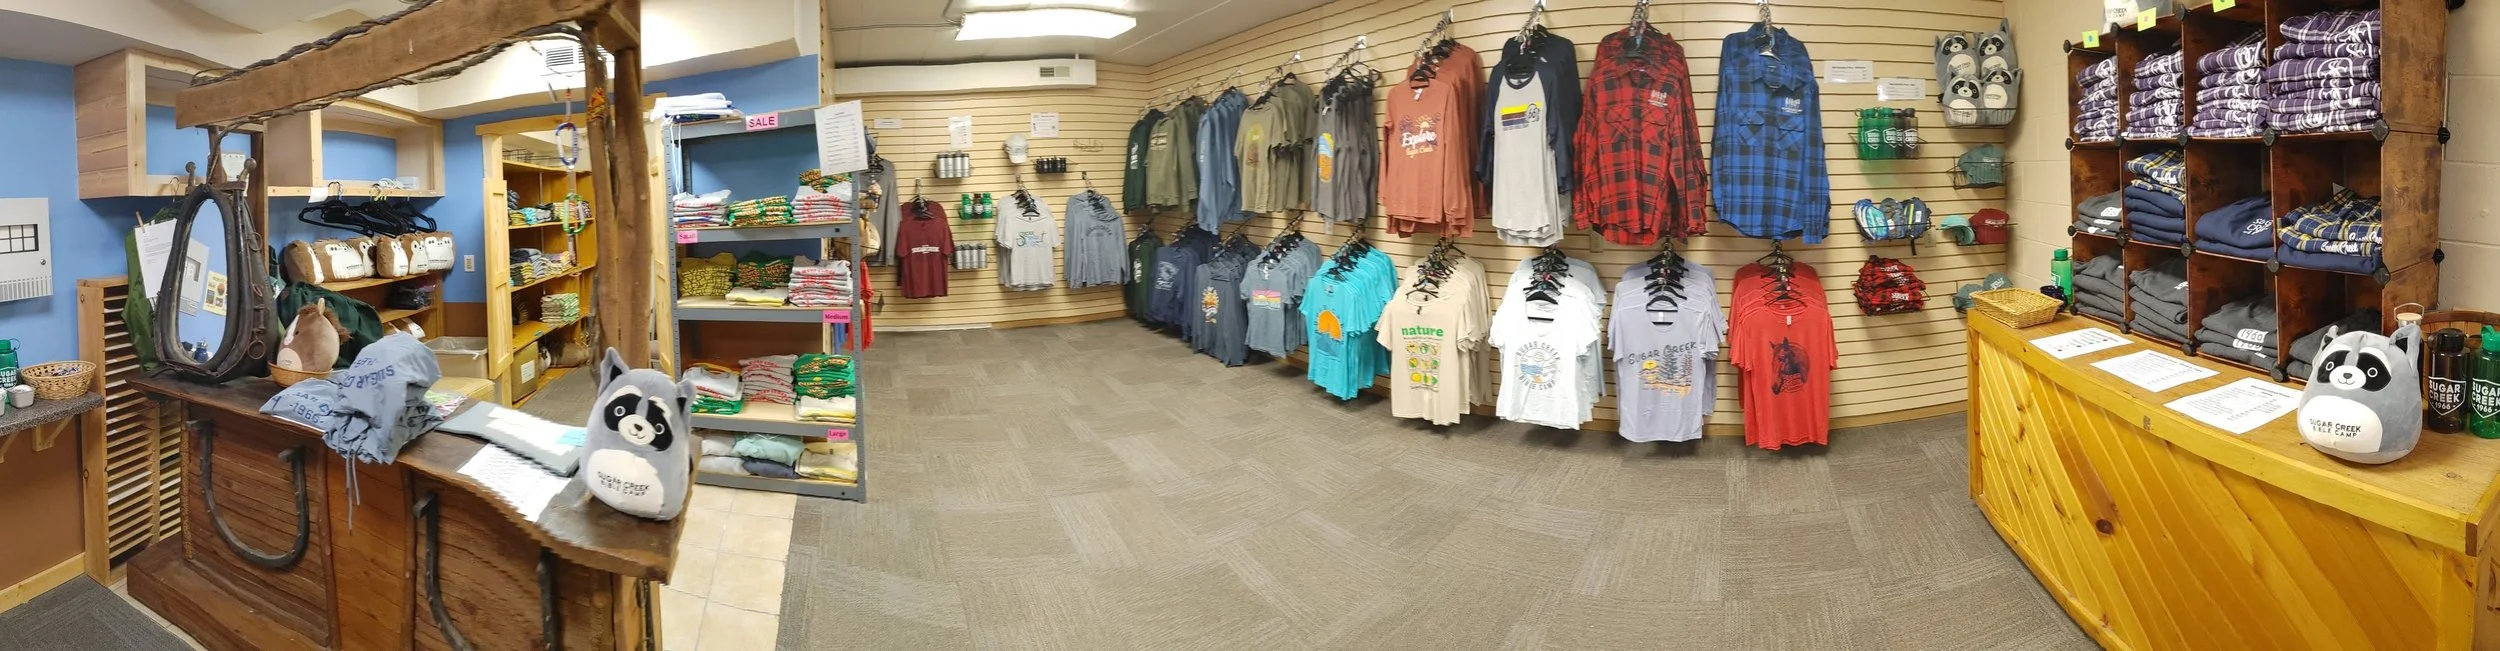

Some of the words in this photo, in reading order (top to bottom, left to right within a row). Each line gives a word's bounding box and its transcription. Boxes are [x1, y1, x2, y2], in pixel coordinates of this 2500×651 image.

[748, 116, 775, 128] SALE
[1401, 325, 1444, 337] nature
[1628, 349, 1661, 365] SUGAR
[2429, 379, 2461, 394] SUGAR
[2429, 389, 2460, 403] CREEK
[2309, 417, 2333, 428] SUGAR
[2335, 422, 2362, 433] CREEK
[2334, 429, 2357, 438] CAMP
